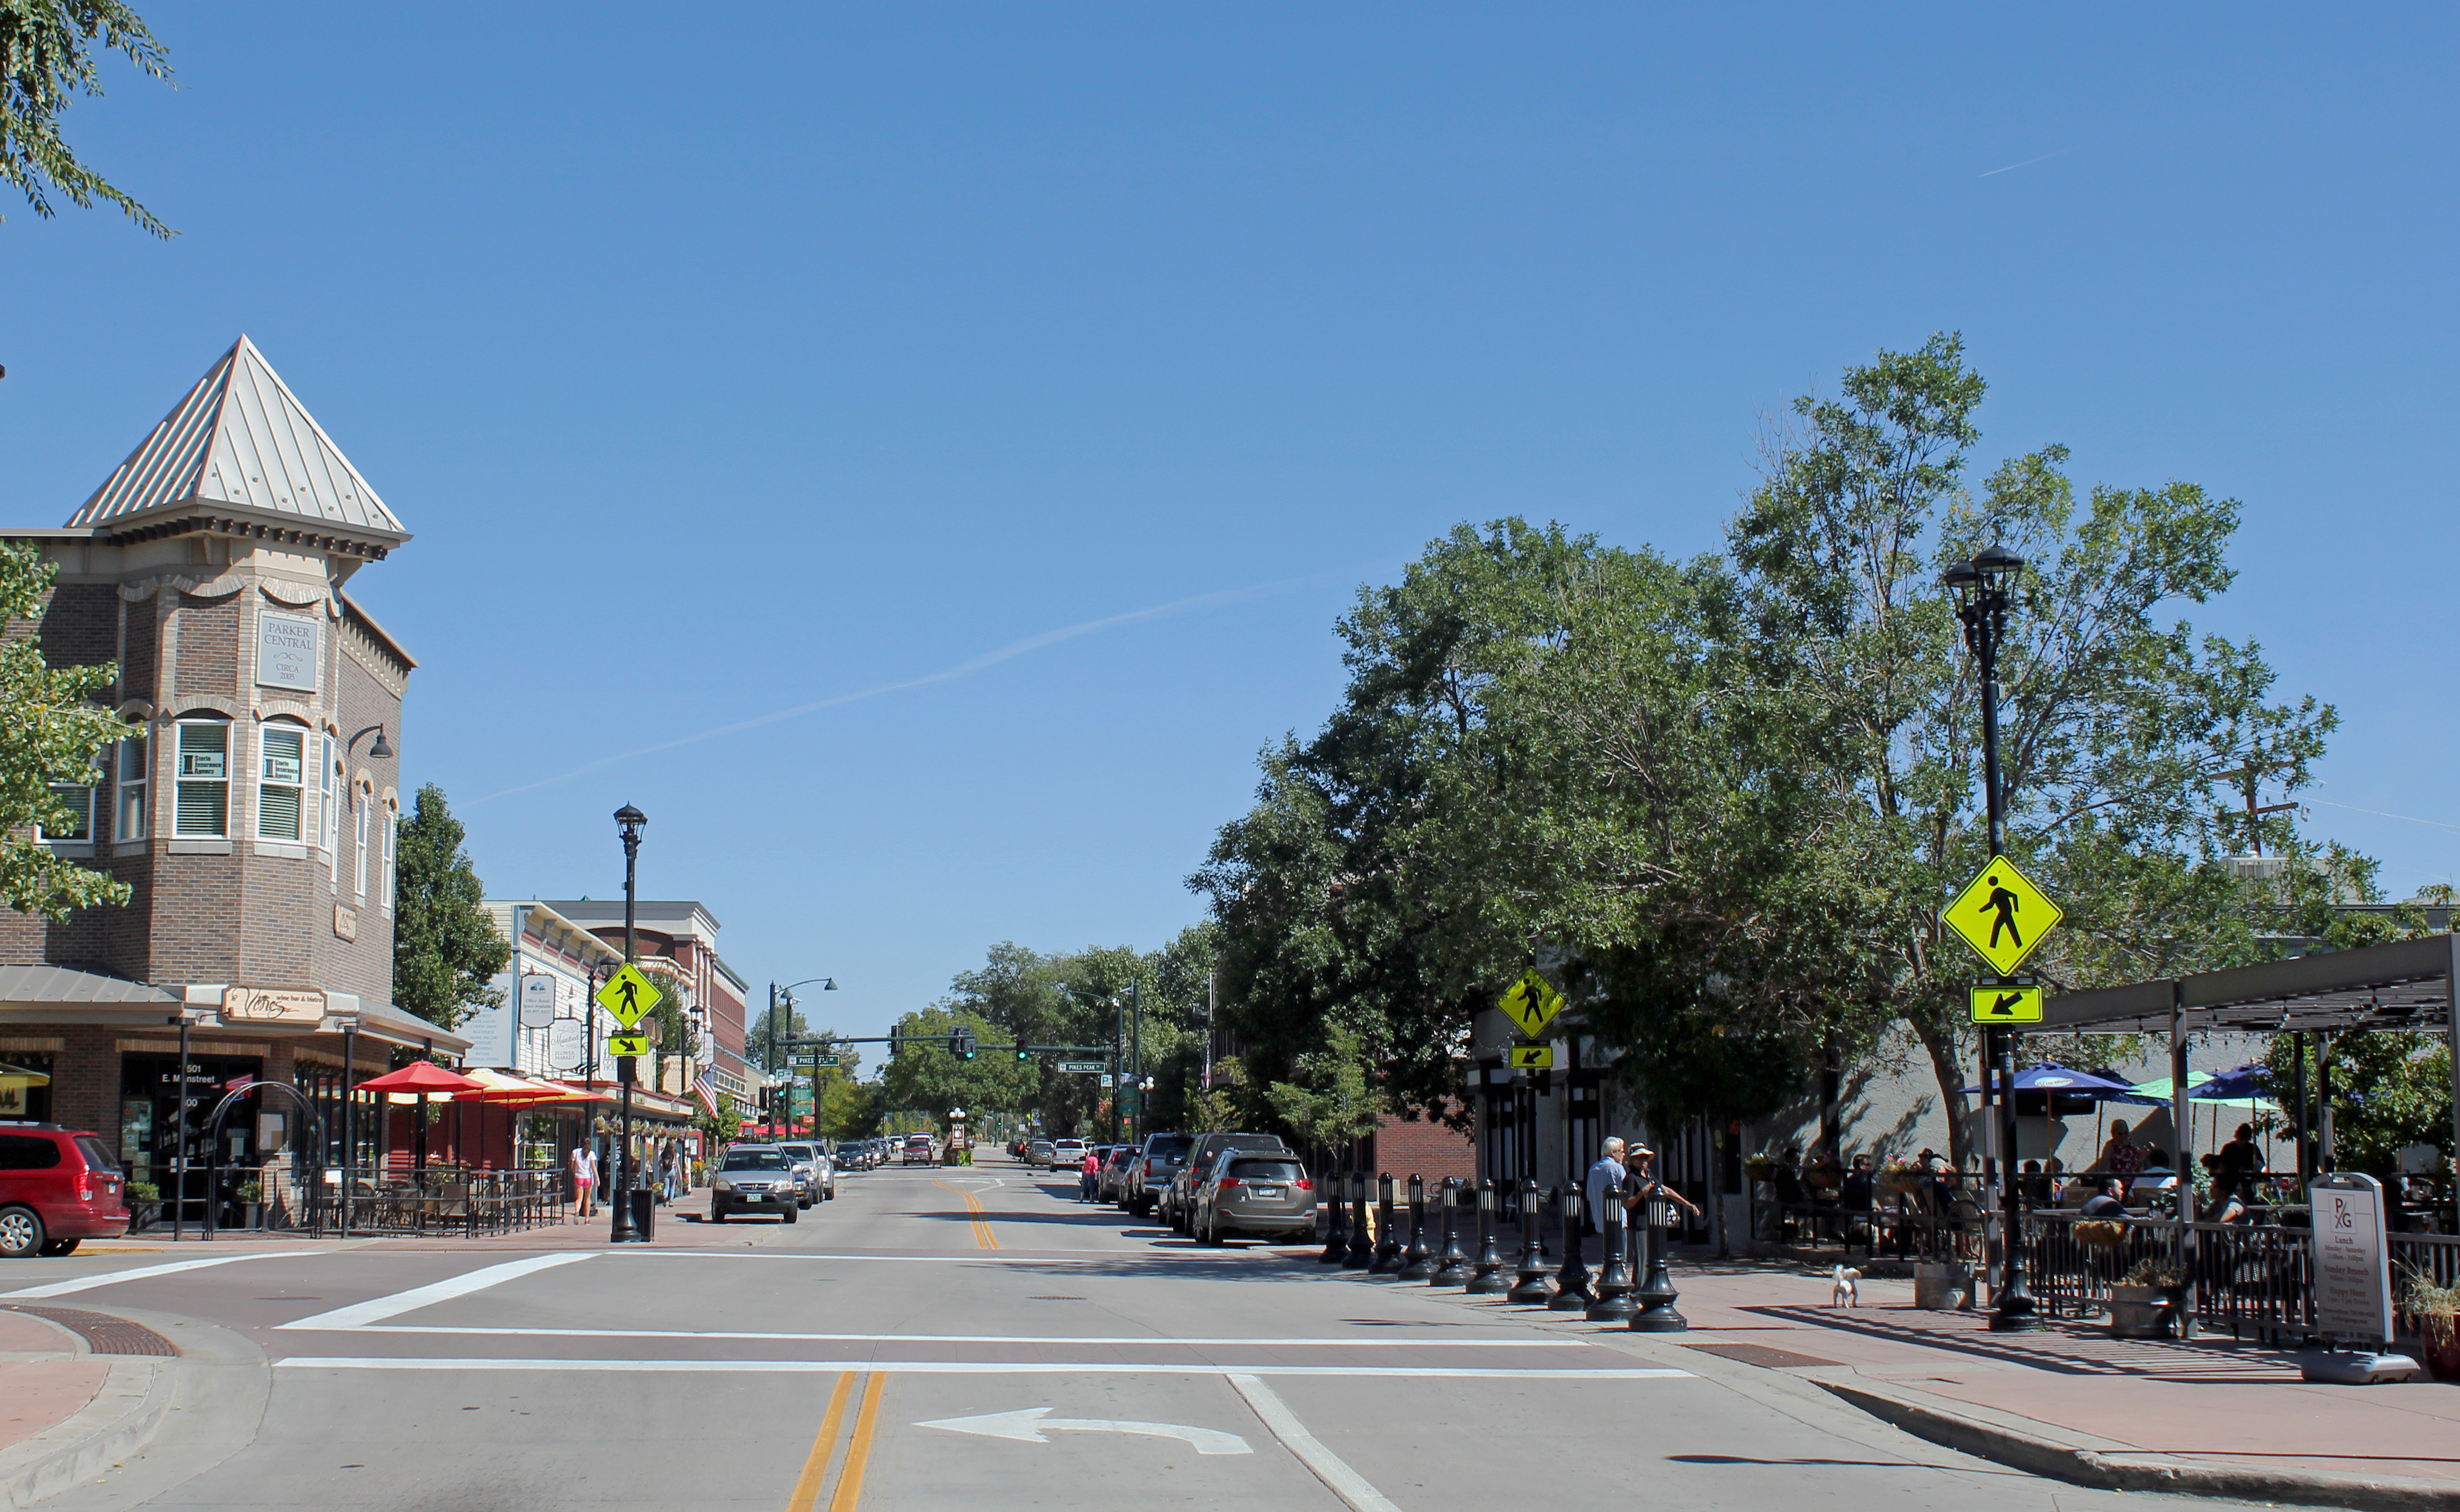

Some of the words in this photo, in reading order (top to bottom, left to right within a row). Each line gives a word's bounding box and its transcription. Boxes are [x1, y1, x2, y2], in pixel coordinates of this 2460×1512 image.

[269, 623, 310, 638] PARKER
[264, 634, 313, 650] CENTRAL
[276, 663, 300, 673] CIRCA
[231, 986, 293, 1019] Vines
[162, 1074, 170, 1082] E.
[172, 1074, 215, 1083] Mnstreet
[1102, 1076, 1109, 1085] P
[2334, 1236, 2353, 1245] Lunch
[2324, 1244, 2342, 1253] Monday
[2345, 1246, 2365, 1254] Saturday
[2323, 1264, 2346, 1274] Sunday
[2346, 1266, 2369, 1276] Brunch
[2329, 1286, 2349, 1297] Happy
[2350, 1287, 2366, 1296] Hour
